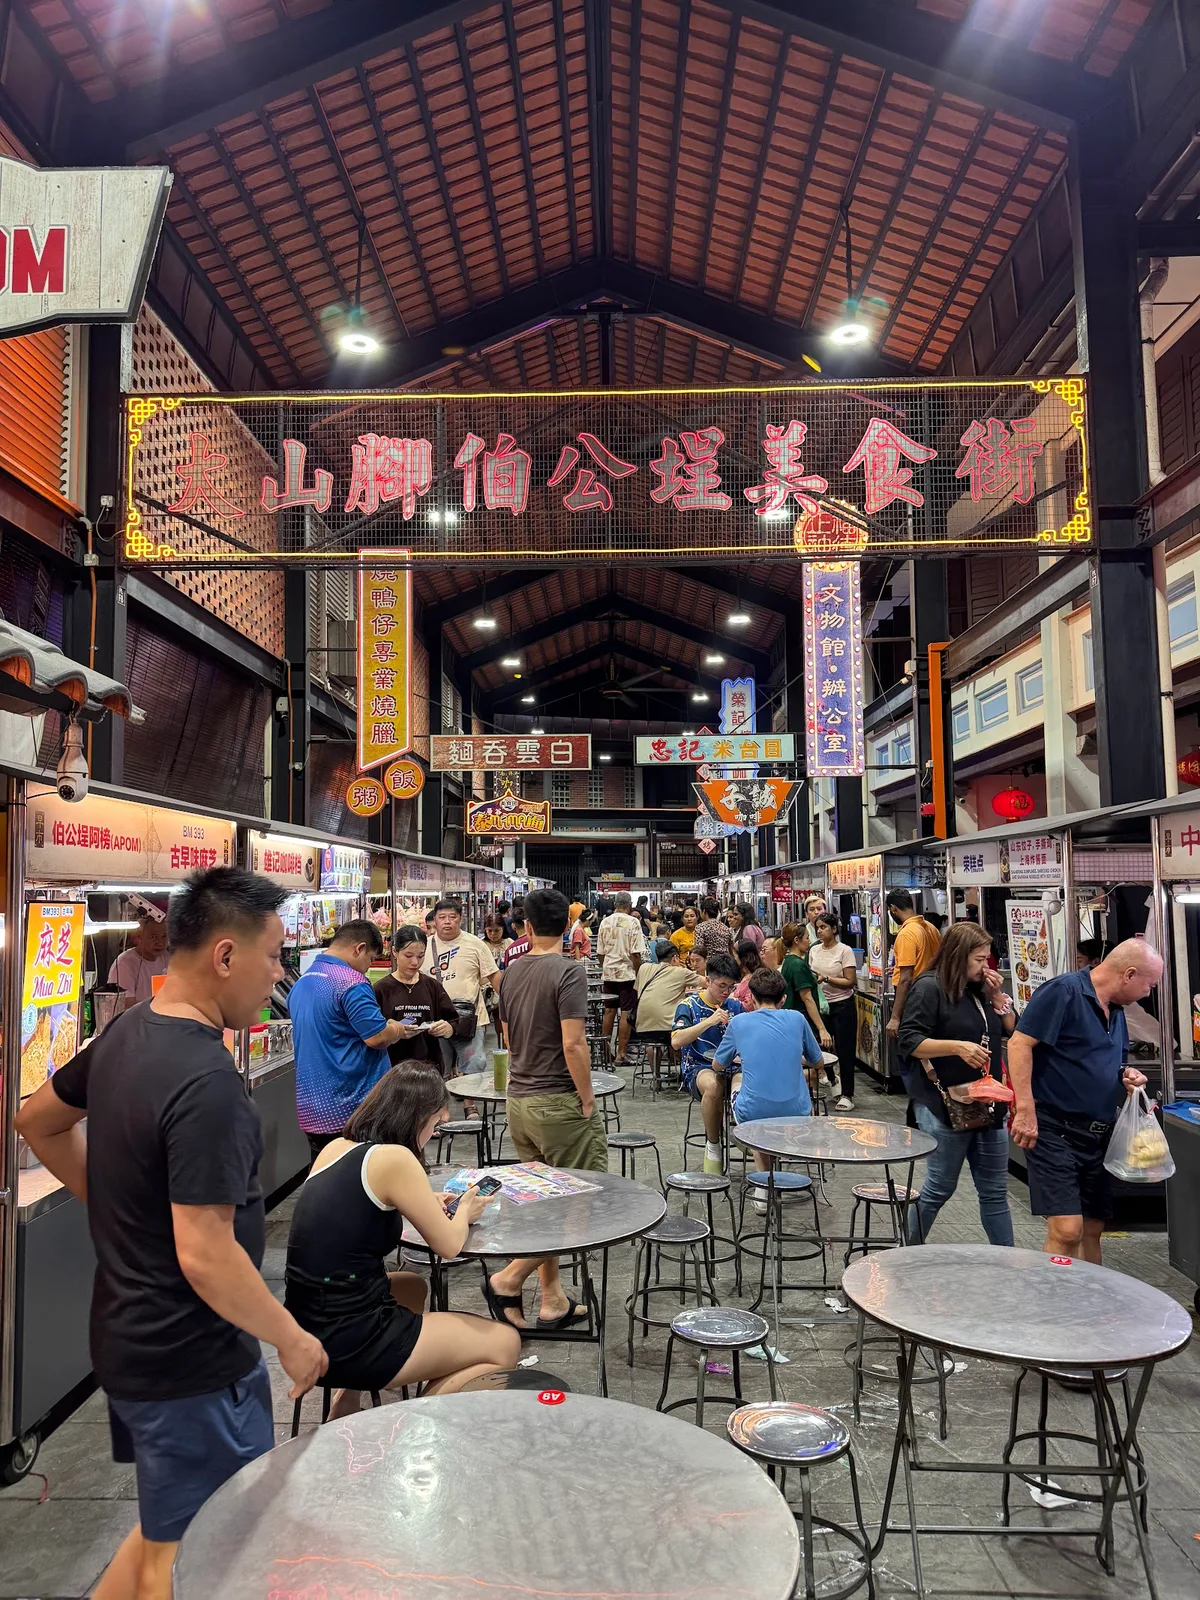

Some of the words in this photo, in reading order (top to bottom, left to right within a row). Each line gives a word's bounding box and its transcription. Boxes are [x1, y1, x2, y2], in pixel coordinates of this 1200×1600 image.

[0, 227, 67, 294] M
[389, 769, 417, 790] 飯
[352, 786, 378, 808] 粥
[734, 812, 763, 824] 咖啡
[182, 825, 193, 838] BM
[193, 827, 205, 840] 393
[34, 924, 73, 967] 麻芝
[33, 975, 53, 998] Mua
